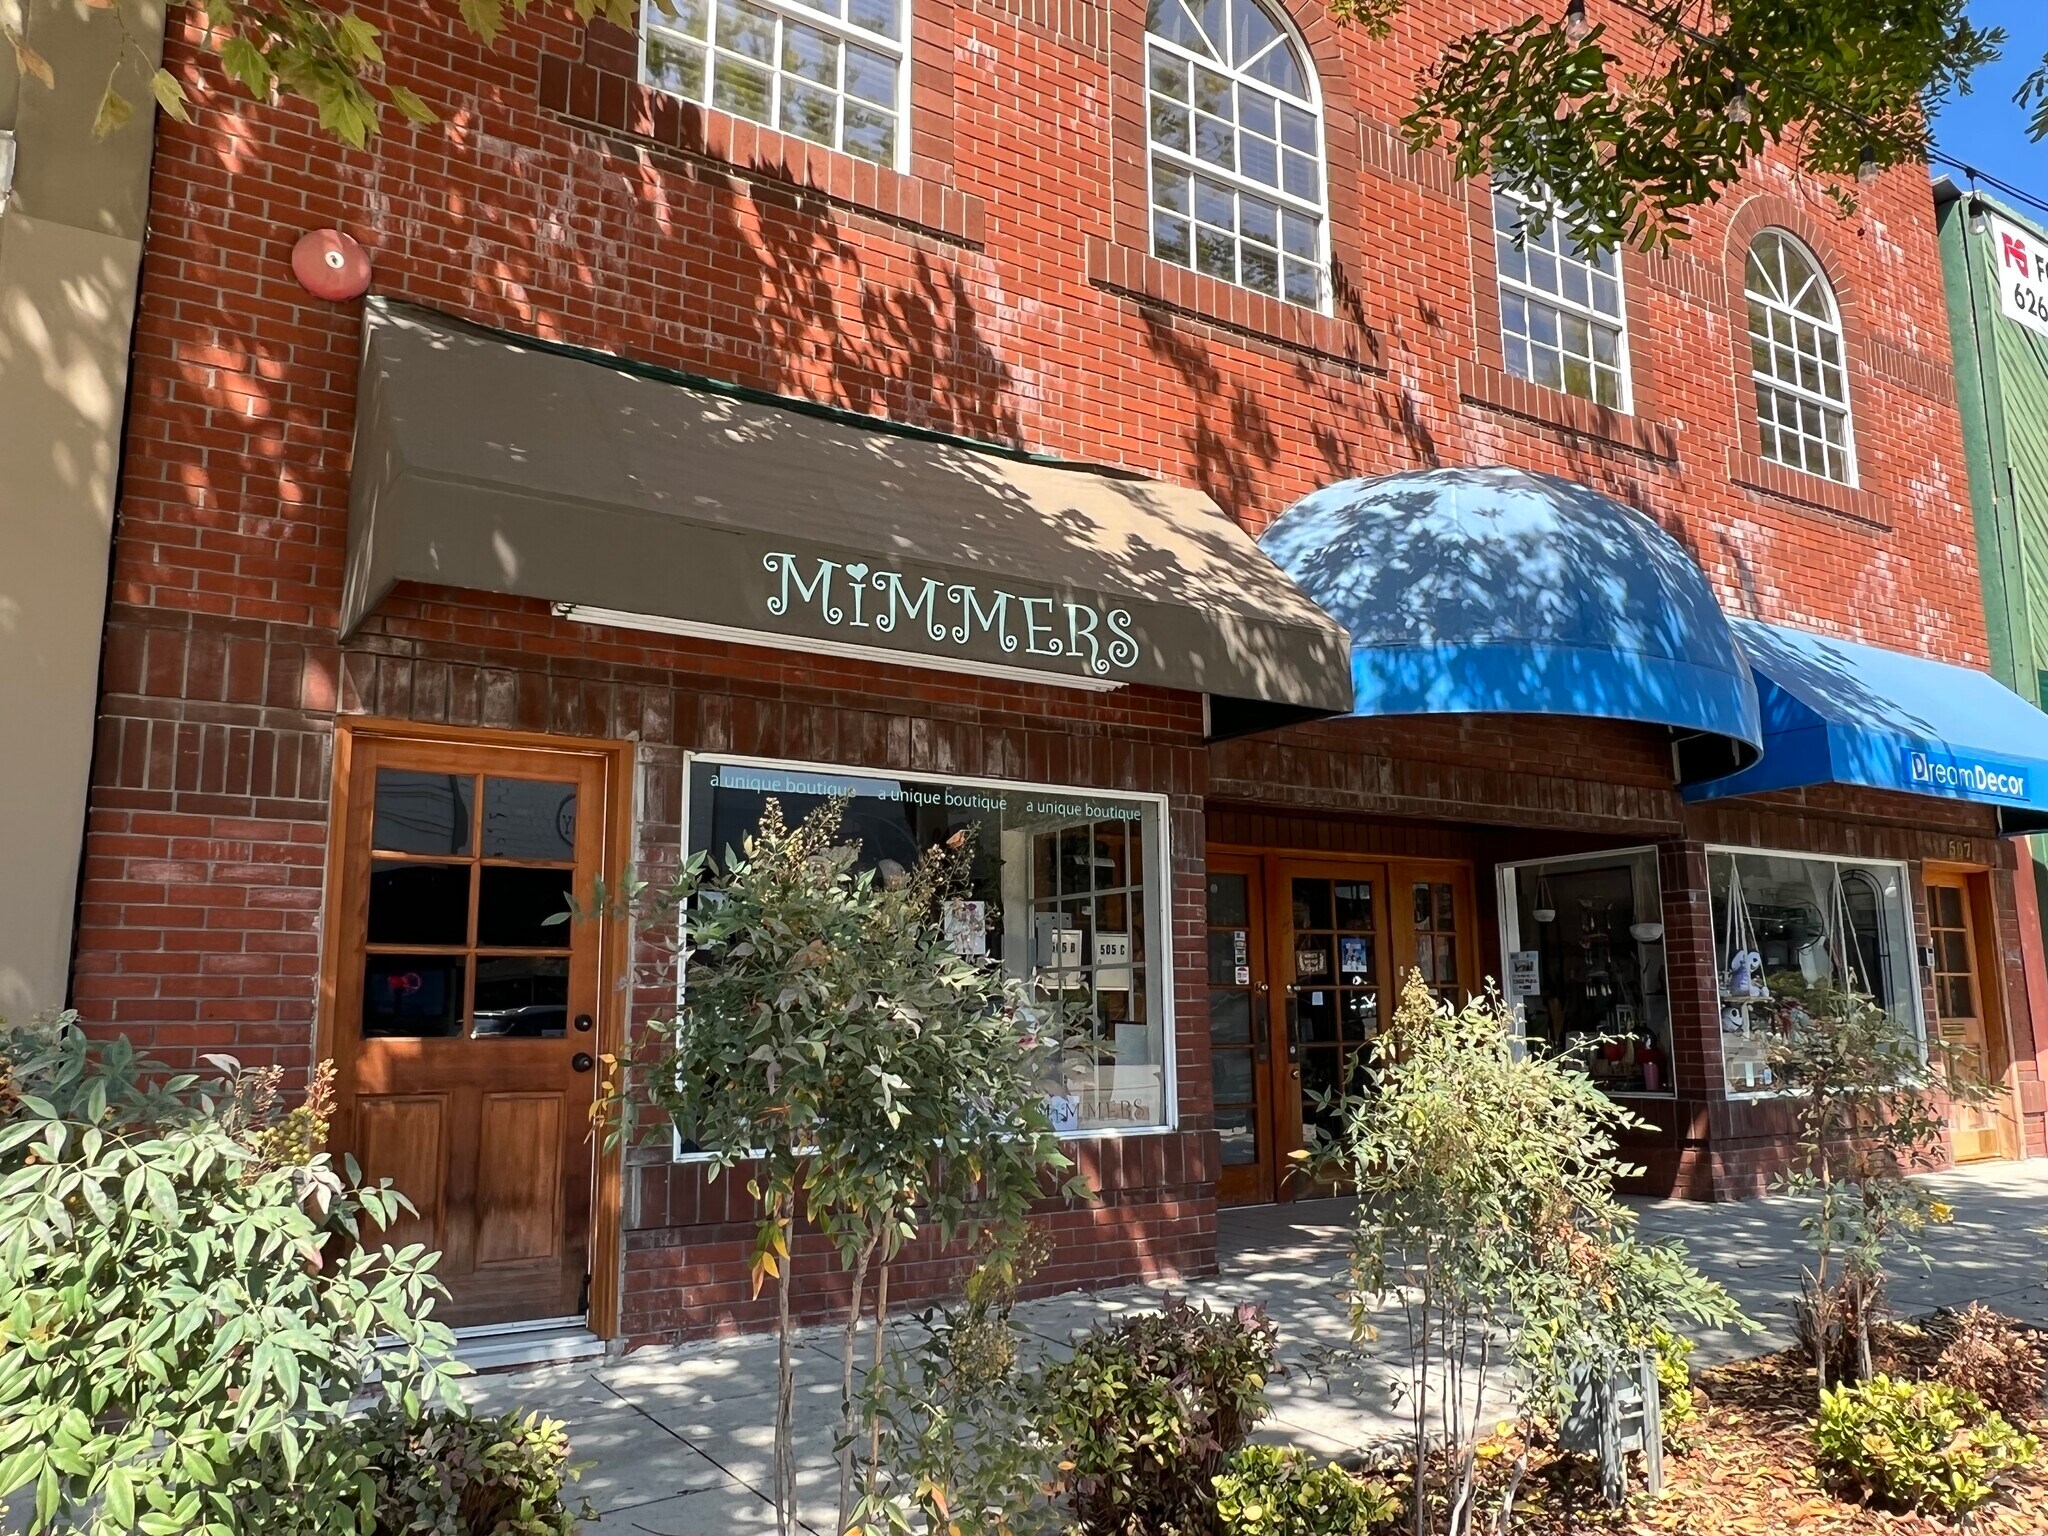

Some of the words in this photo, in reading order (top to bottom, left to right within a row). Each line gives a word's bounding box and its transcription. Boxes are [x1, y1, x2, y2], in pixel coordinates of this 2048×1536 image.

[2035, 253, 2048, 282] F
[710, 774, 719, 787] a
[725, 774, 781, 793] unique
[1911, 752, 2024, 796] DreamDecor
[878, 787, 886, 800] a
[890, 787, 941, 808] unique
[945, 786, 1007, 811] boutique
[1026, 801, 1033, 812] a
[1037, 801, 1082, 817] unique
[1085, 803, 1141, 822] boutique
[1070, 942, 1076, 954] B
[1100, 944, 1117, 955] 505
